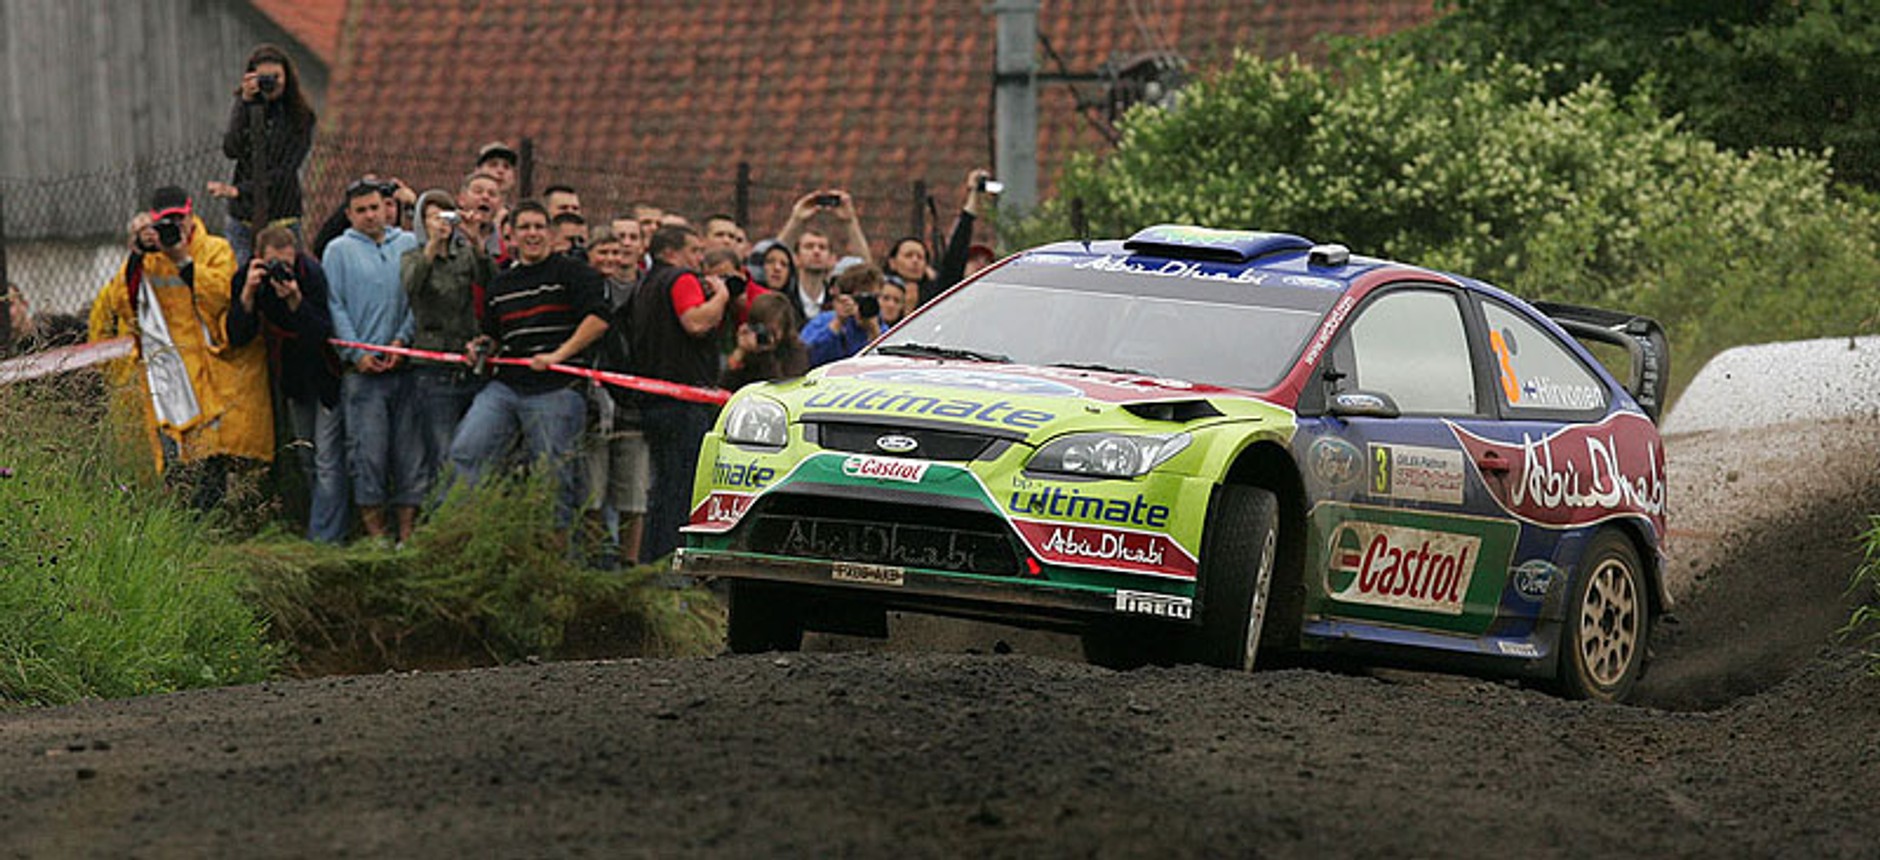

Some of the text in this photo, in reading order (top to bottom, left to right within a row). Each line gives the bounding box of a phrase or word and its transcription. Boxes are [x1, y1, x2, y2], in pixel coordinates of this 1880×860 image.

[1490, 330, 1520, 403] 3
[803, 387, 1056, 429] ultimate
[1534, 376, 1606, 408] Hirvonen
[861, 456, 923, 480] Castrol
[1375, 447, 1388, 492] 3
[1009, 486, 1170, 527] ultimate
[1358, 533, 1468, 603] Castrol
[1115, 589, 1193, 620] PIRELLI
